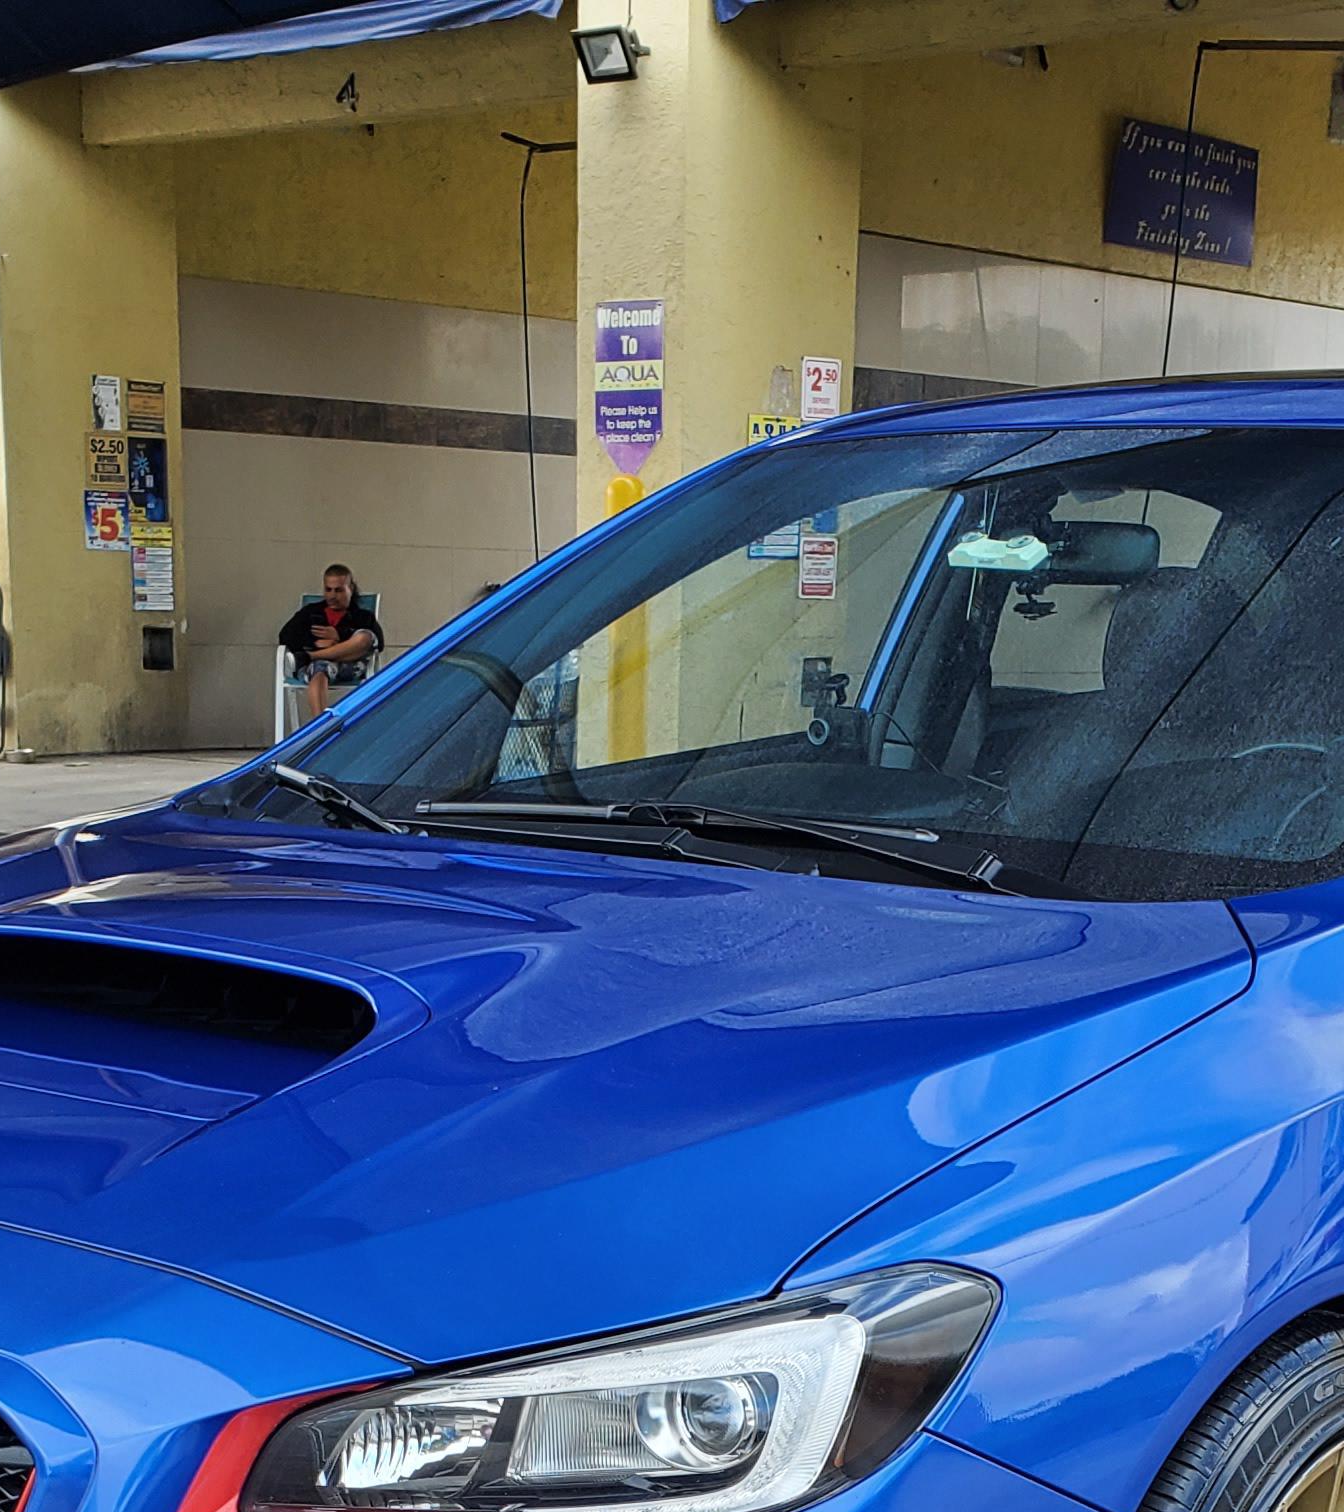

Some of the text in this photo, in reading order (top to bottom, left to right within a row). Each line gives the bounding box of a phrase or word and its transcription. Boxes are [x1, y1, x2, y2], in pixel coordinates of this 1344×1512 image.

[336, 72, 359, 112] 4
[1167, 138, 1192, 153] wan
[597, 306, 662, 329] Welcome
[620, 335, 639, 355] To
[599, 365, 660, 382] AQUA
[600, 405, 627, 416] Please
[90, 439, 125, 454] $2.50
